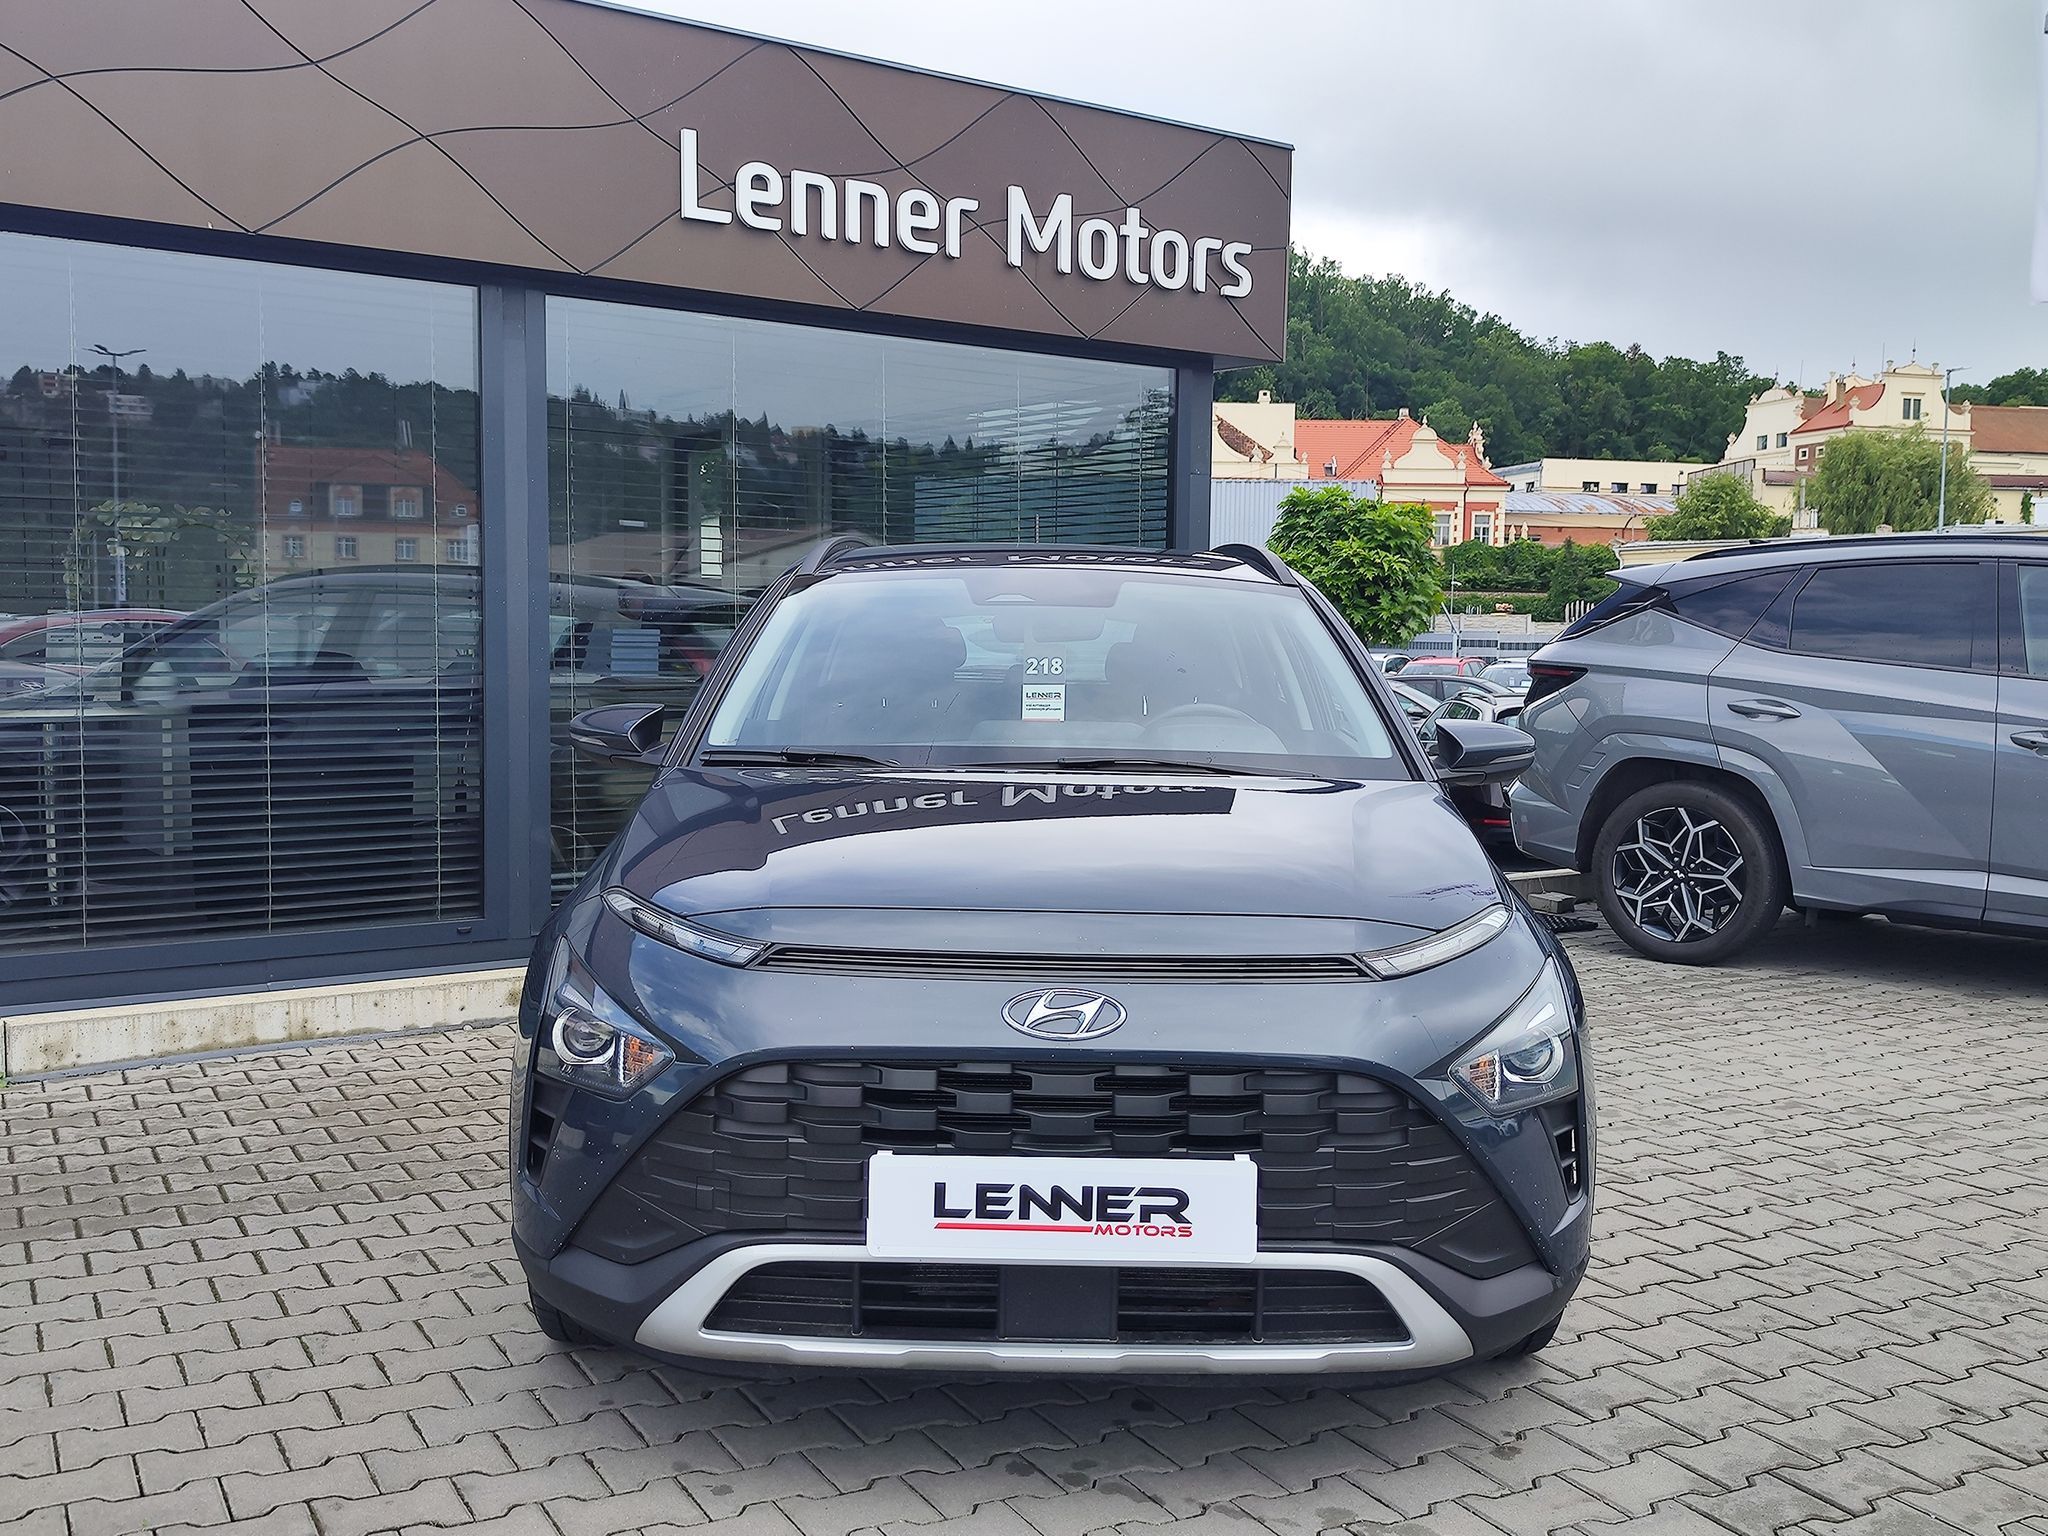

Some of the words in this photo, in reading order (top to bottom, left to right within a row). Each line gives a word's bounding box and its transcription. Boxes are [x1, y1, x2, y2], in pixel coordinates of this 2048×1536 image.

[680, 128, 979, 260] Lenner
[1006, 185, 1254, 299] Motors
[1025, 657, 1064, 675] 218
[933, 1181, 1193, 1225] LENNER
[1093, 1223, 1193, 1238] MOTORS
